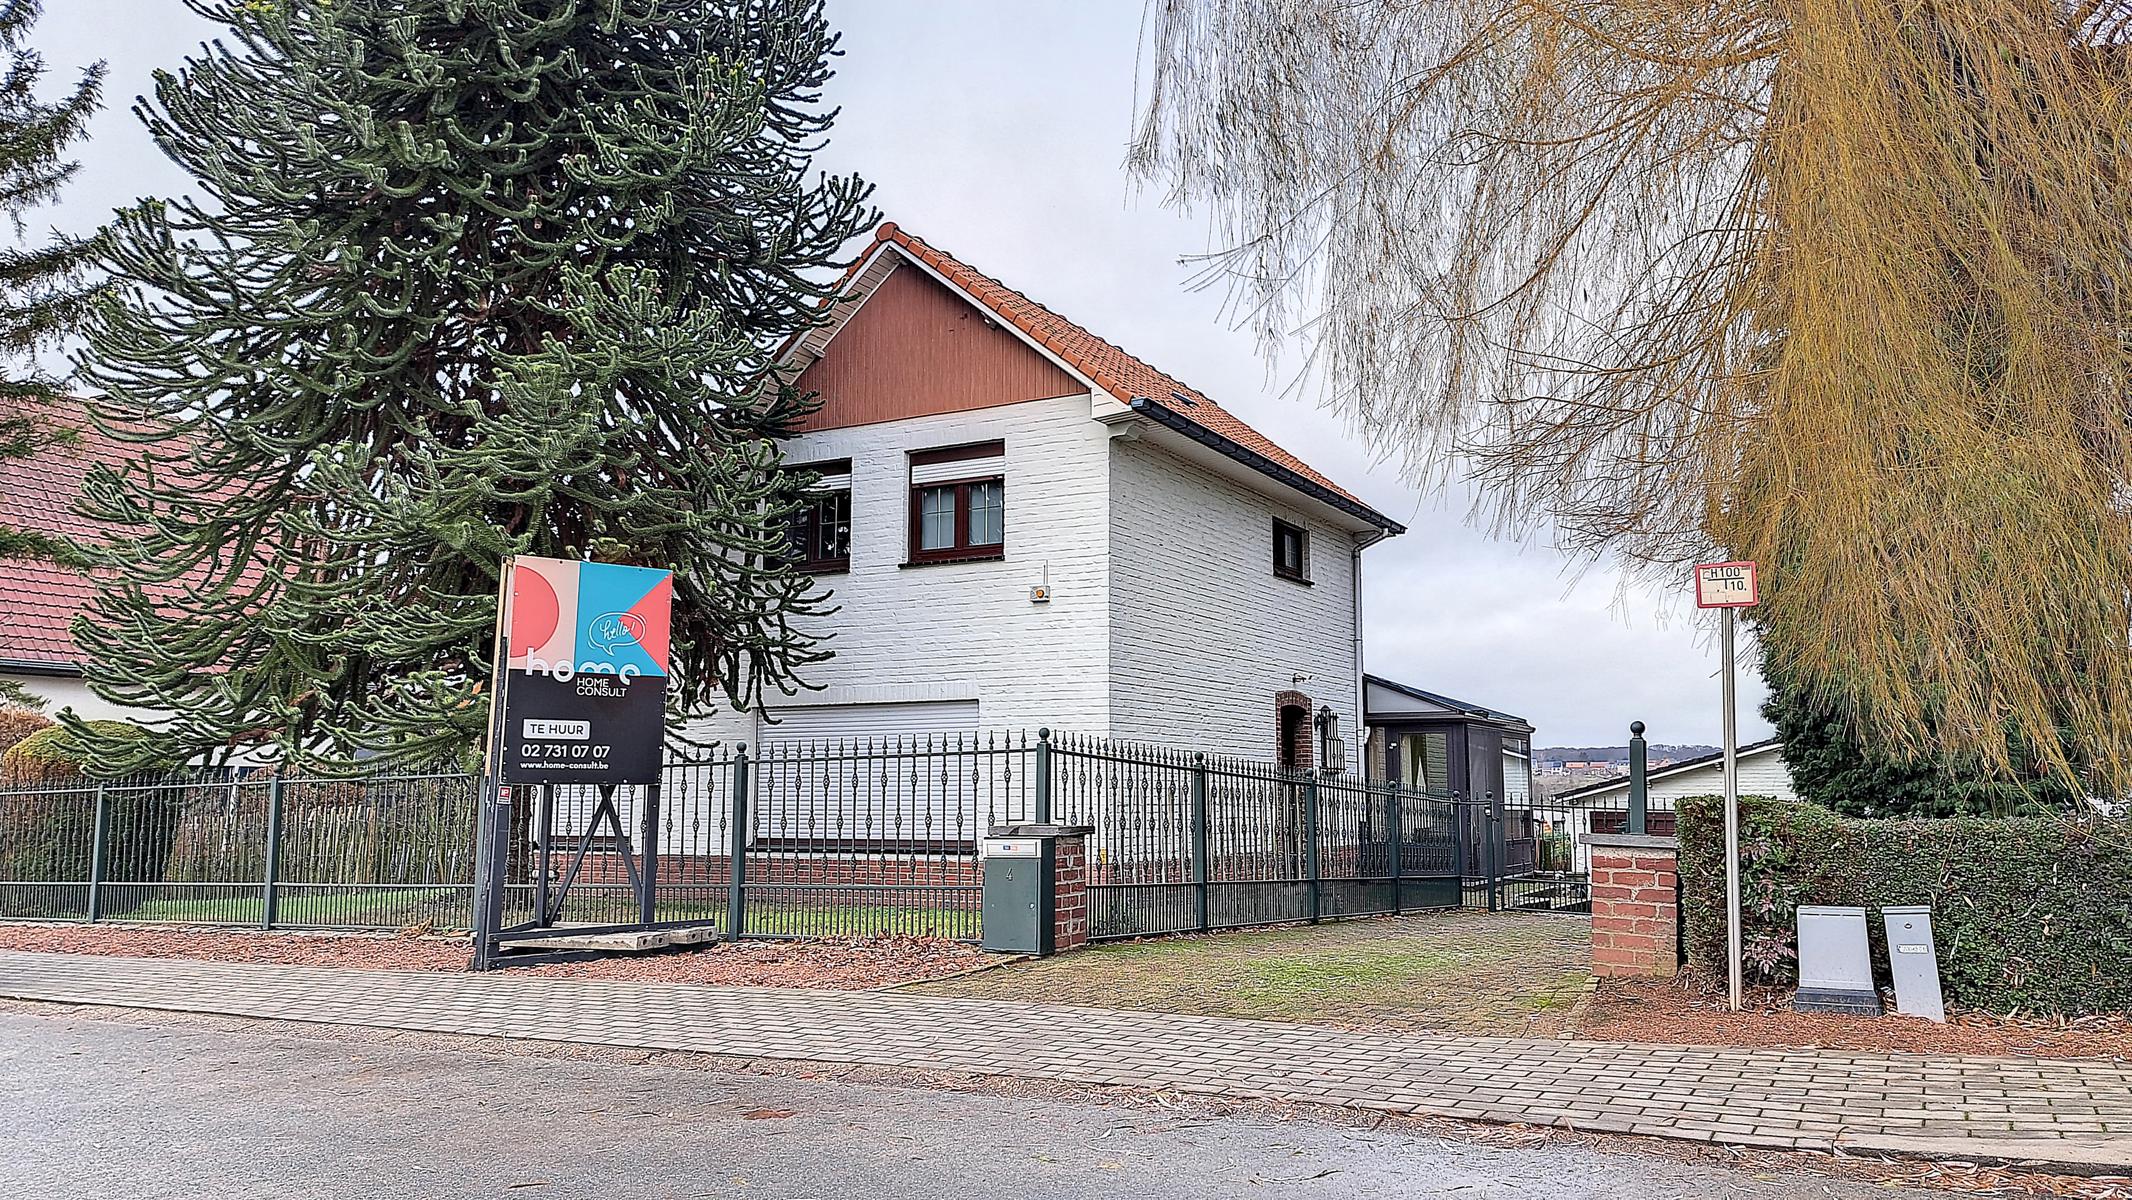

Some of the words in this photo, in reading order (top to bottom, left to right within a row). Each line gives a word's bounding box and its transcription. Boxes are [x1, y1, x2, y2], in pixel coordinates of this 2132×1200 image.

[600, 619, 635, 641] hello!
[525, 647, 641, 686] home
[577, 677, 610, 688] HOME
[576, 686, 628, 698] CONSULT
[530, 723, 545, 734] TE
[548, 724, 584, 735] HUUR
[521, 744, 541, 757] 02
[544, 745, 568, 757] 731
[571, 745, 590, 758] 07
[592, 746, 611, 758] 07
[520, 760, 609, 770] www.home-consult.be
[1006, 867, 1013, 881] 4
